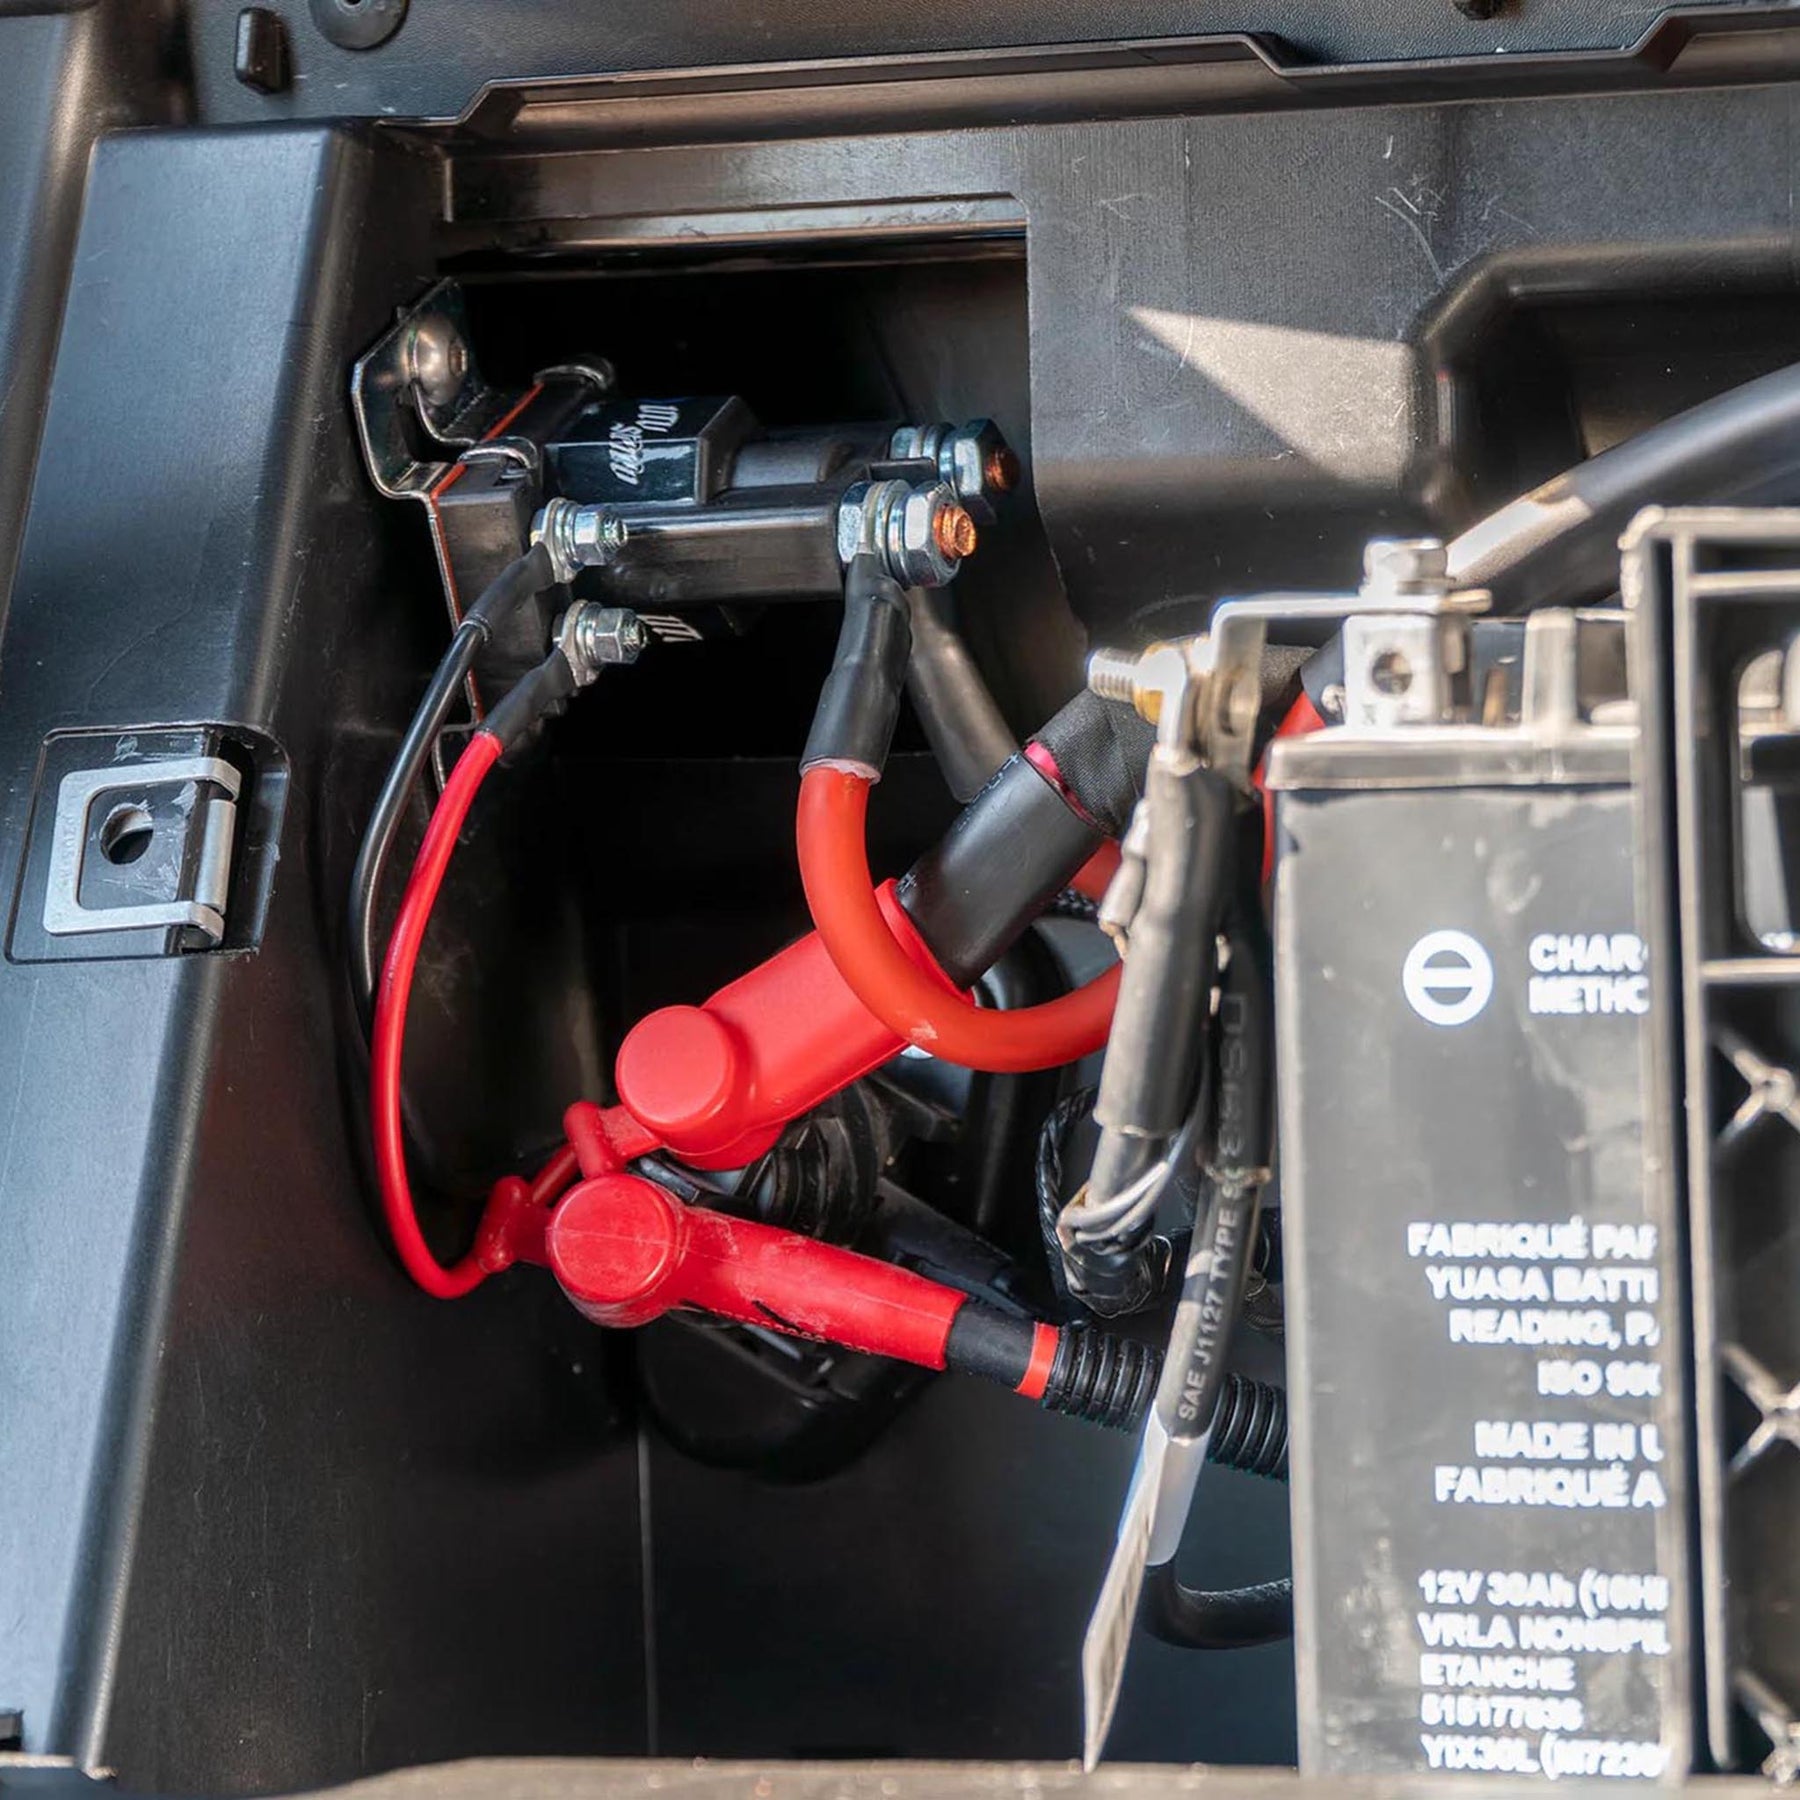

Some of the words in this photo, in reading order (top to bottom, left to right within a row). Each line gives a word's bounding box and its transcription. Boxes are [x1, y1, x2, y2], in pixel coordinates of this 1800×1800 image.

[1529, 934, 1648, 972] CHAR
[1209, 1208, 1240, 1282] TYPE
[1425, 1265, 1549, 1302] YUASA
[1192, 1290, 1225, 1366] J1127
[1449, 1308, 1621, 1350] READING,
[1625, 1311, 1660, 1346] P
[1177, 1369, 1208, 1421] SAE
[1474, 1421, 1589, 1460] MADE
[1593, 1424, 1636, 1461] IN
[1435, 1462, 1630, 1508] FABRIQUÉ
[1418, 1569, 1484, 1605] 12V
[1487, 1571, 1576, 1608] 30Ah
[1417, 1612, 1516, 1649] VRLA
